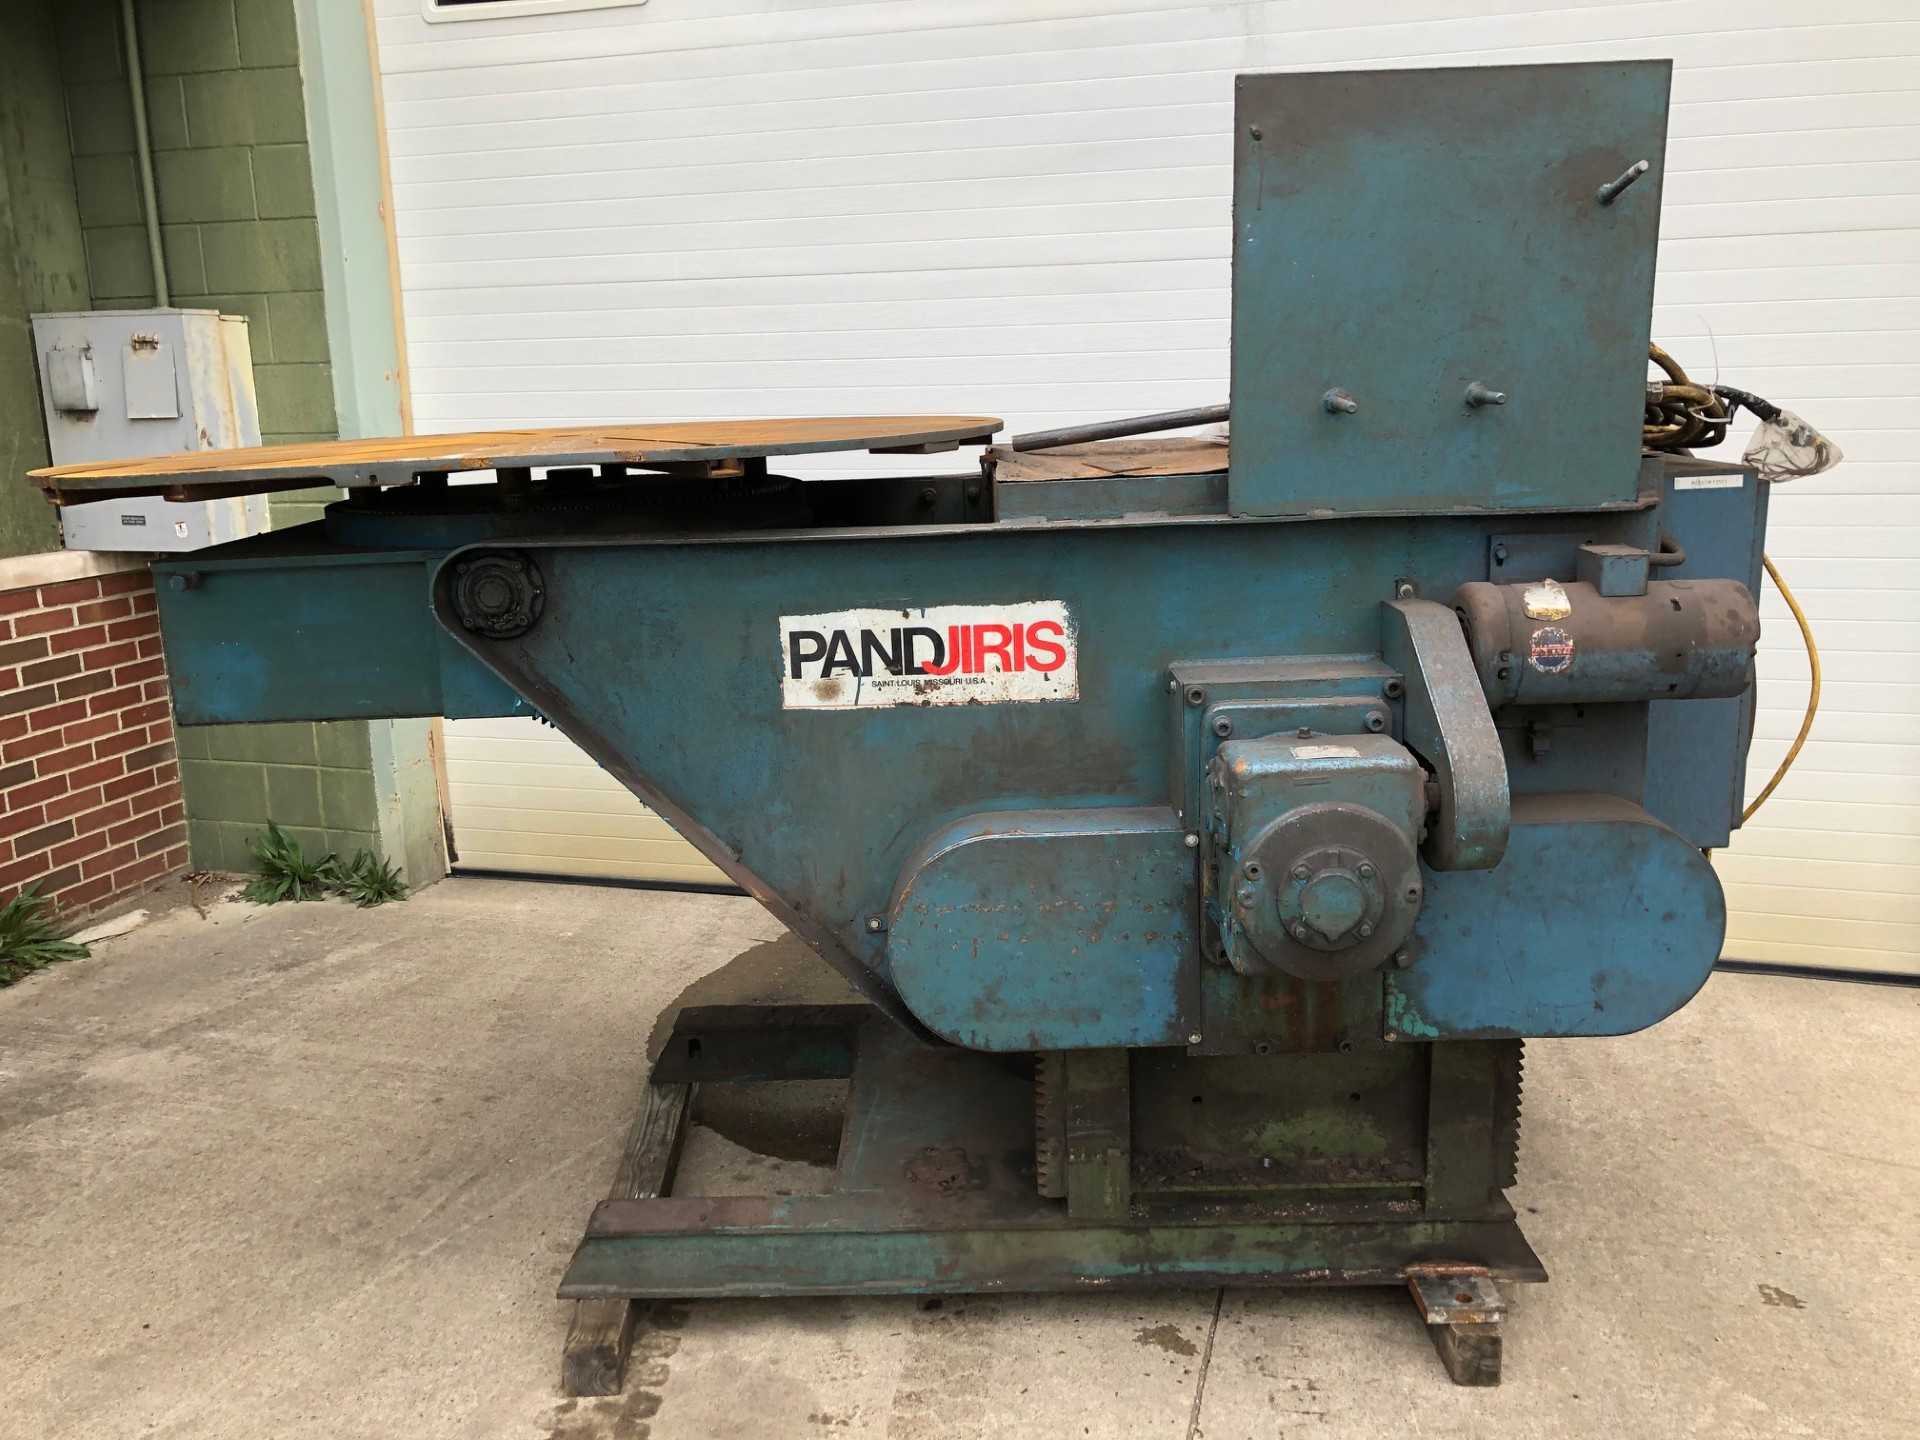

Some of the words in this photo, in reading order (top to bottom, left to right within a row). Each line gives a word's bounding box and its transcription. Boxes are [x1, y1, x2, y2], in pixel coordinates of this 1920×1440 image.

[788, 620, 1067, 679] PANDJIRIS
[871, 680, 894, 688] SAINT
[924, 677, 963, 687] MISSOURI
